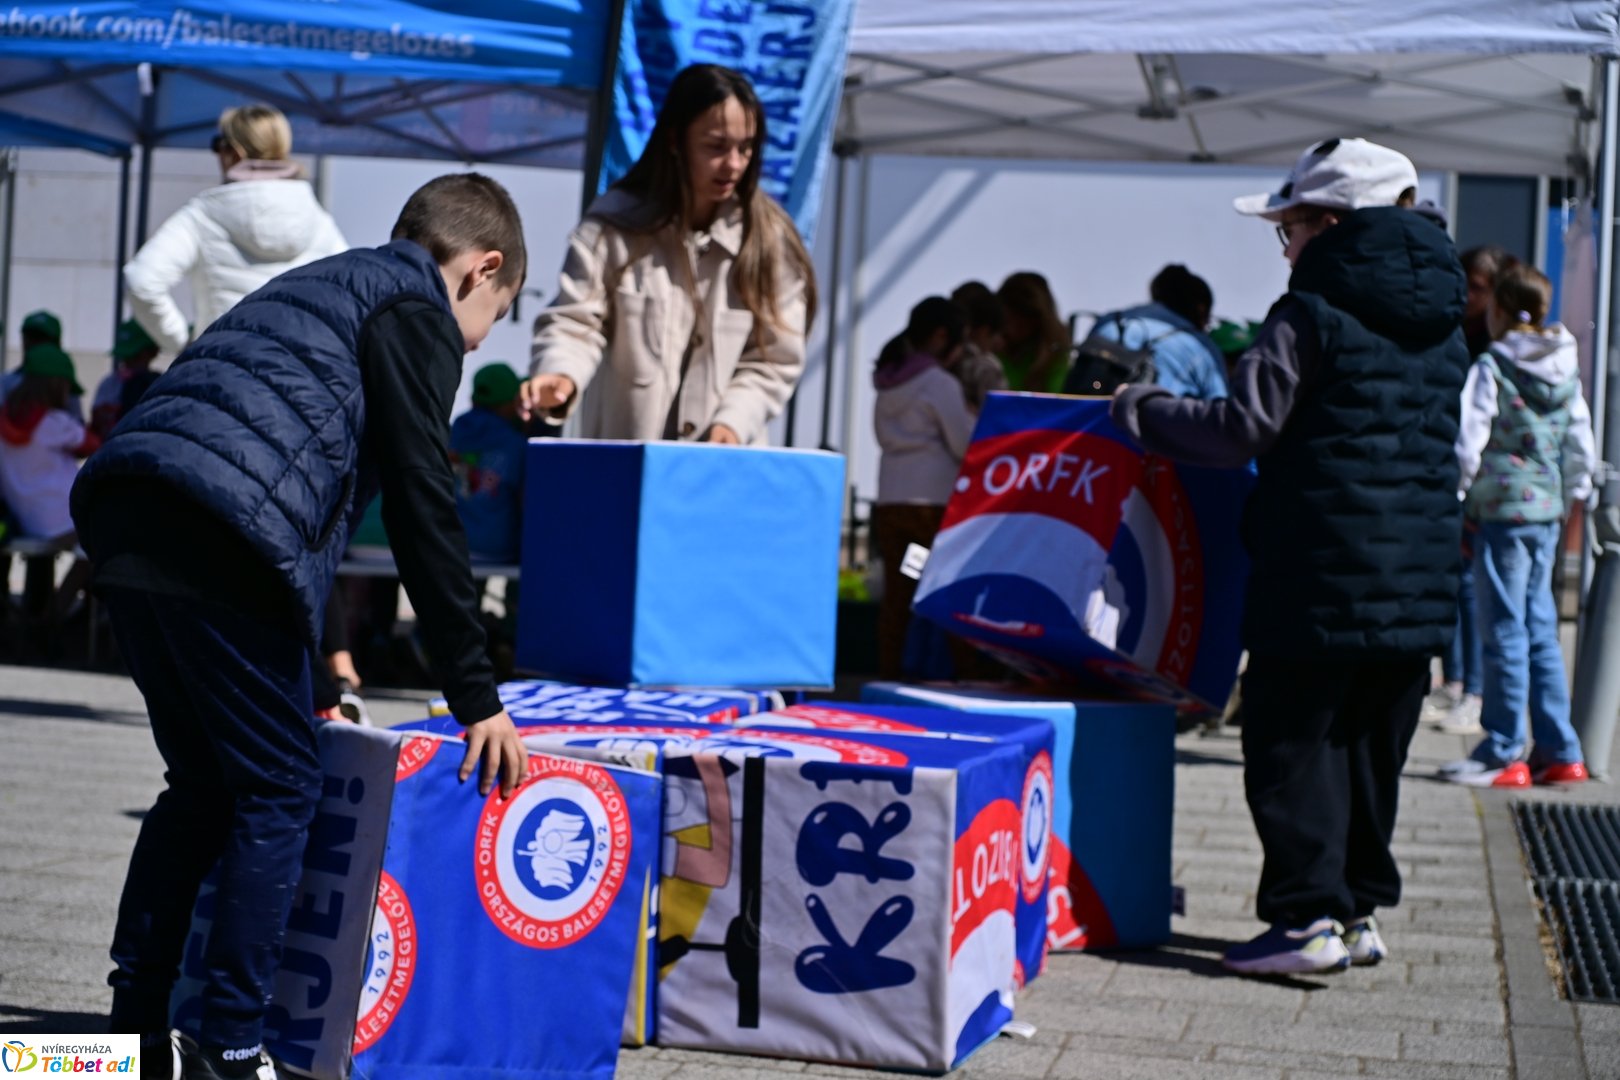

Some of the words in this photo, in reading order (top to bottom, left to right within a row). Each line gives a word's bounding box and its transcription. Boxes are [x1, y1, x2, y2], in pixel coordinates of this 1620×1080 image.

[982, 453, 1111, 505] ORFK
[479, 812, 498, 865] ORFK
[589, 824, 608, 883] 1992
[483, 882, 559, 942] ORSZÁGOS
[369, 931, 390, 995] 1992
